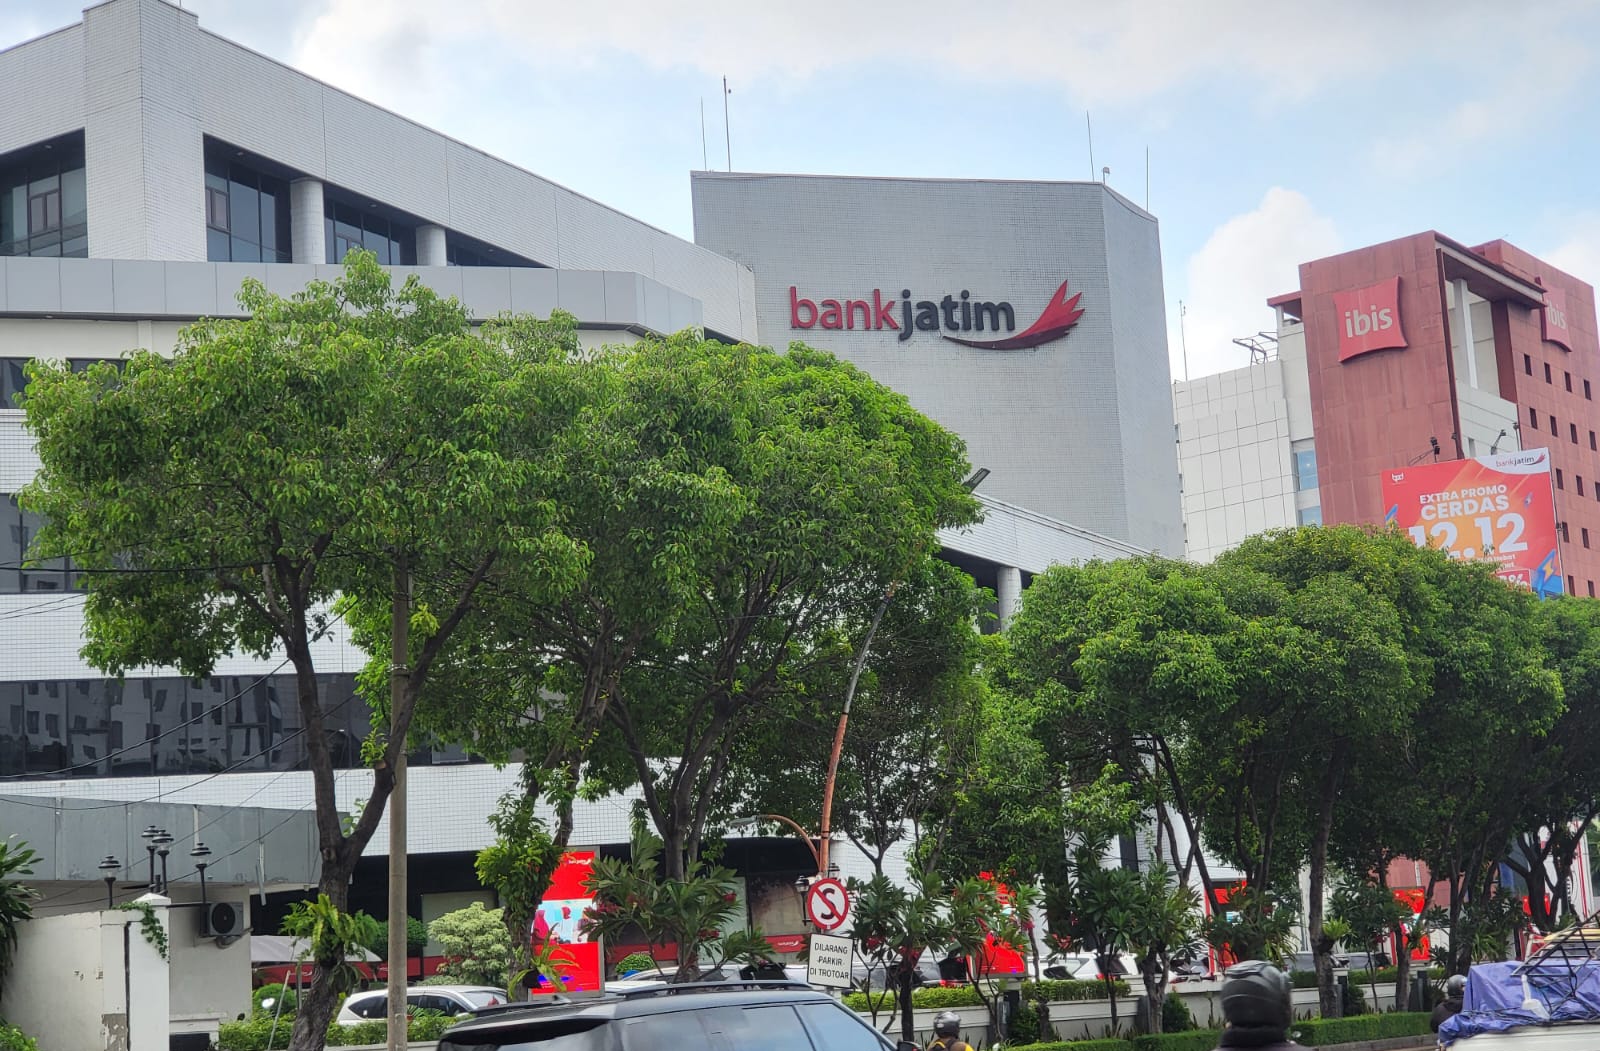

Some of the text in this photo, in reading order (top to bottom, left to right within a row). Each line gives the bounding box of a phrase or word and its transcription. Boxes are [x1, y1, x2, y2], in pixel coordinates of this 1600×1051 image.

[790, 286, 1016, 342] bankjatim
[1345, 305, 1394, 338] ibis
[1419, 484, 1507, 504] EXTRA PROMO
[1421, 494, 1510, 521] CERDAS
[1408, 512, 1529, 560] 12.12
[814, 942, 848, 955] DILARANG
[818, 955, 843, 966] PARKIR
[809, 967, 849, 980] DI TROTOAR
